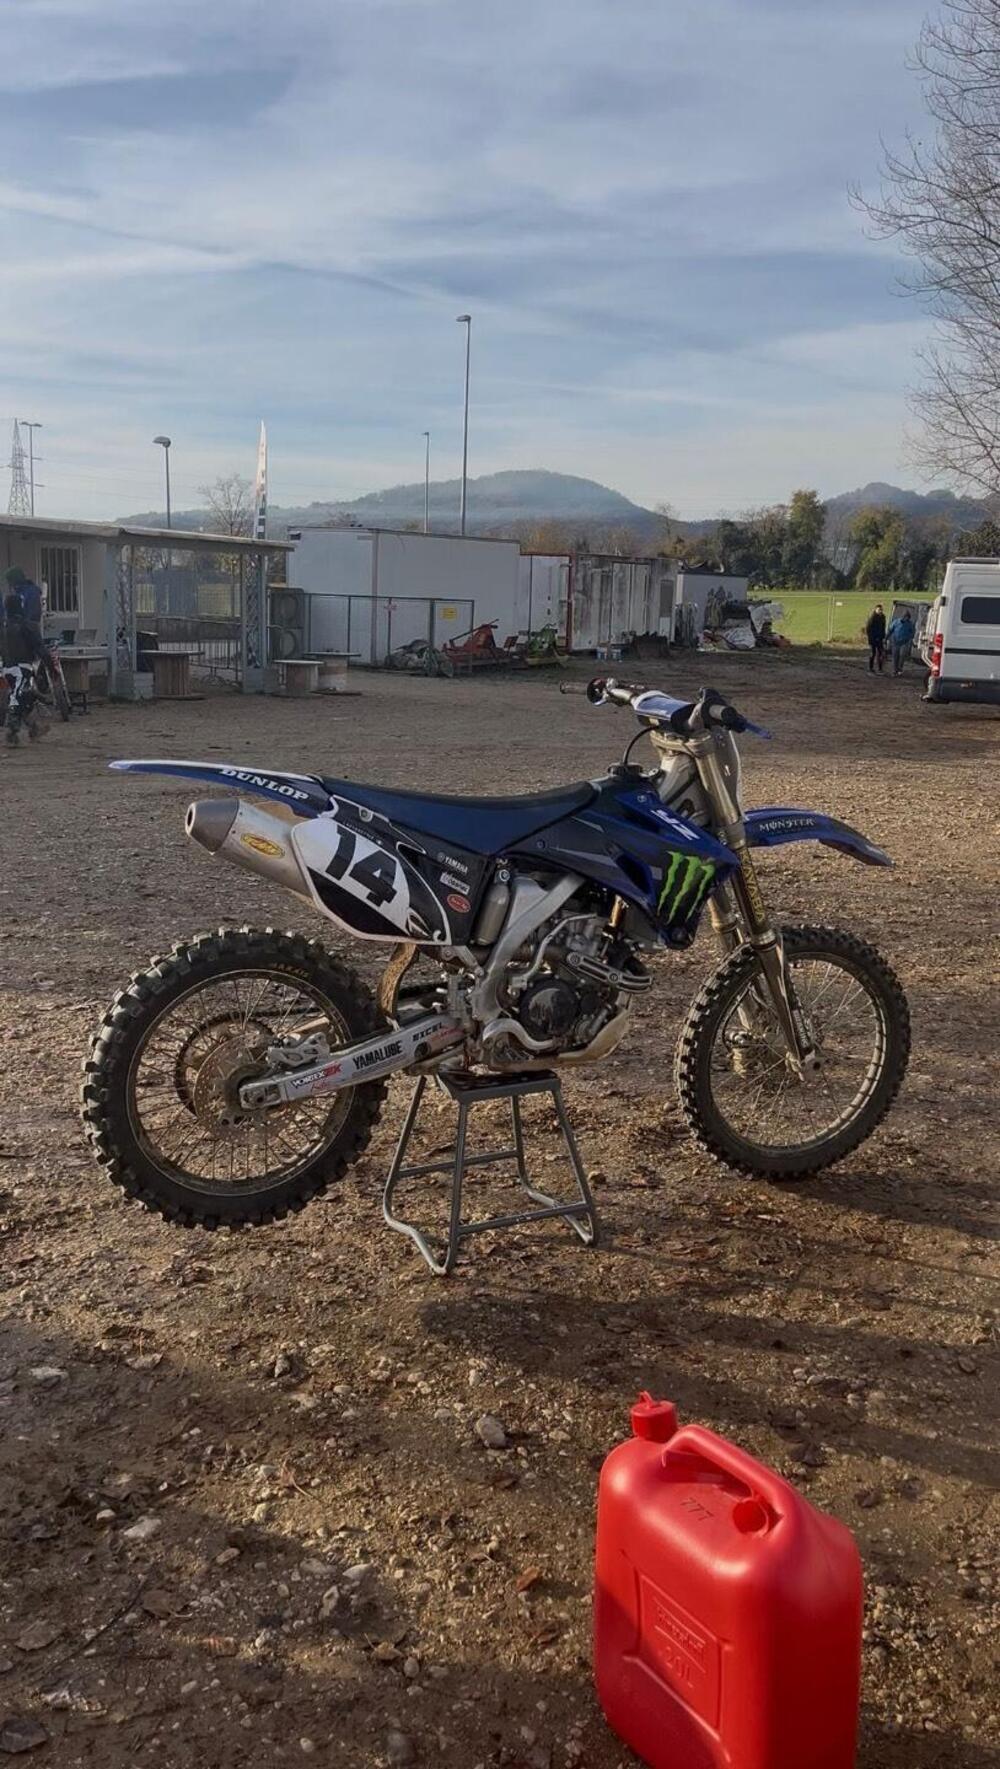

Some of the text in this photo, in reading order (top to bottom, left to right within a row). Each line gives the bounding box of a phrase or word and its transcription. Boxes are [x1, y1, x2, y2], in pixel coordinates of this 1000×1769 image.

[219, 768, 309, 799] DUNLOP
[759, 818, 816, 832] MONSTER
[325, 823, 398, 907] 14
[445, 856, 468, 873] YAMAHA
[352, 1040, 403, 1070] YAMALUBE
